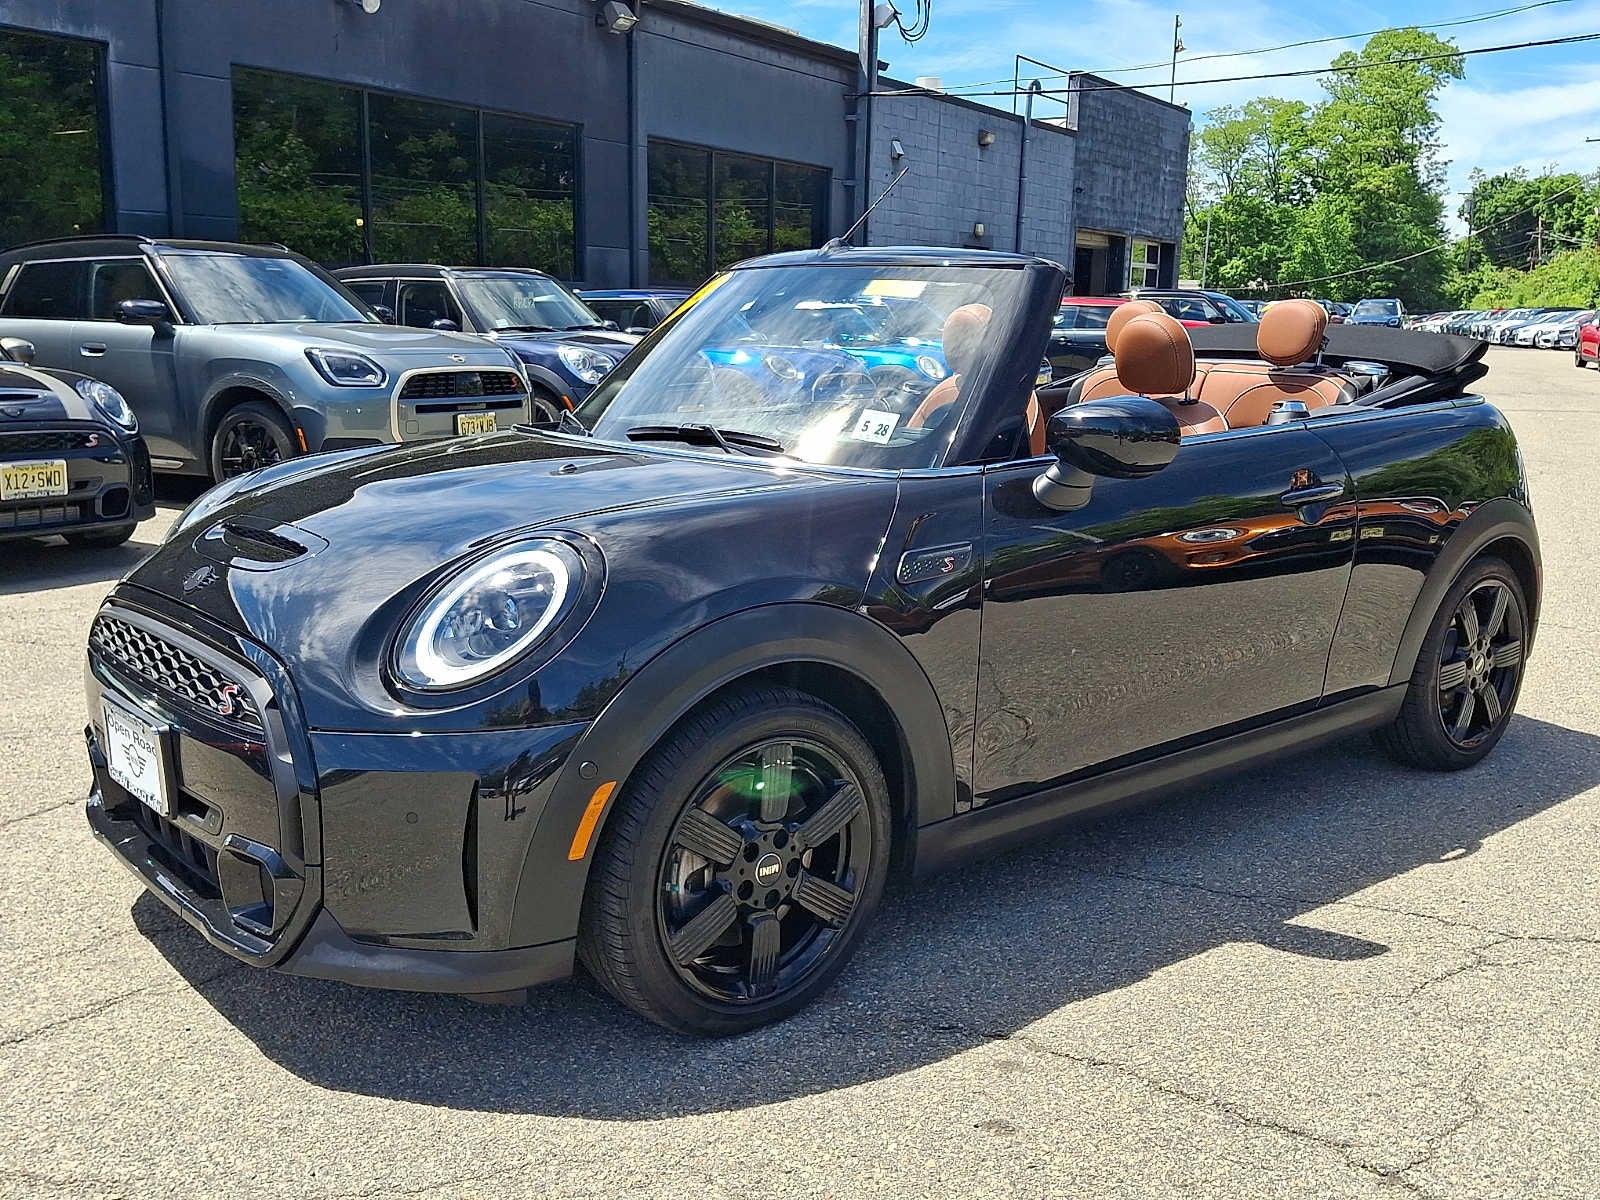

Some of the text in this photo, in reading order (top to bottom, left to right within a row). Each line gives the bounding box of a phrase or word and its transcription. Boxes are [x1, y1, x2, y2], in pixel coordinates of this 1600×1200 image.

[861, 420, 890, 437] 5 28
[86, 433, 99, 448] S
[941, 556, 955, 573] S
[218, 685, 238, 715] S
[107, 713, 131, 740] Open
[759, 863, 780, 877] MINI
